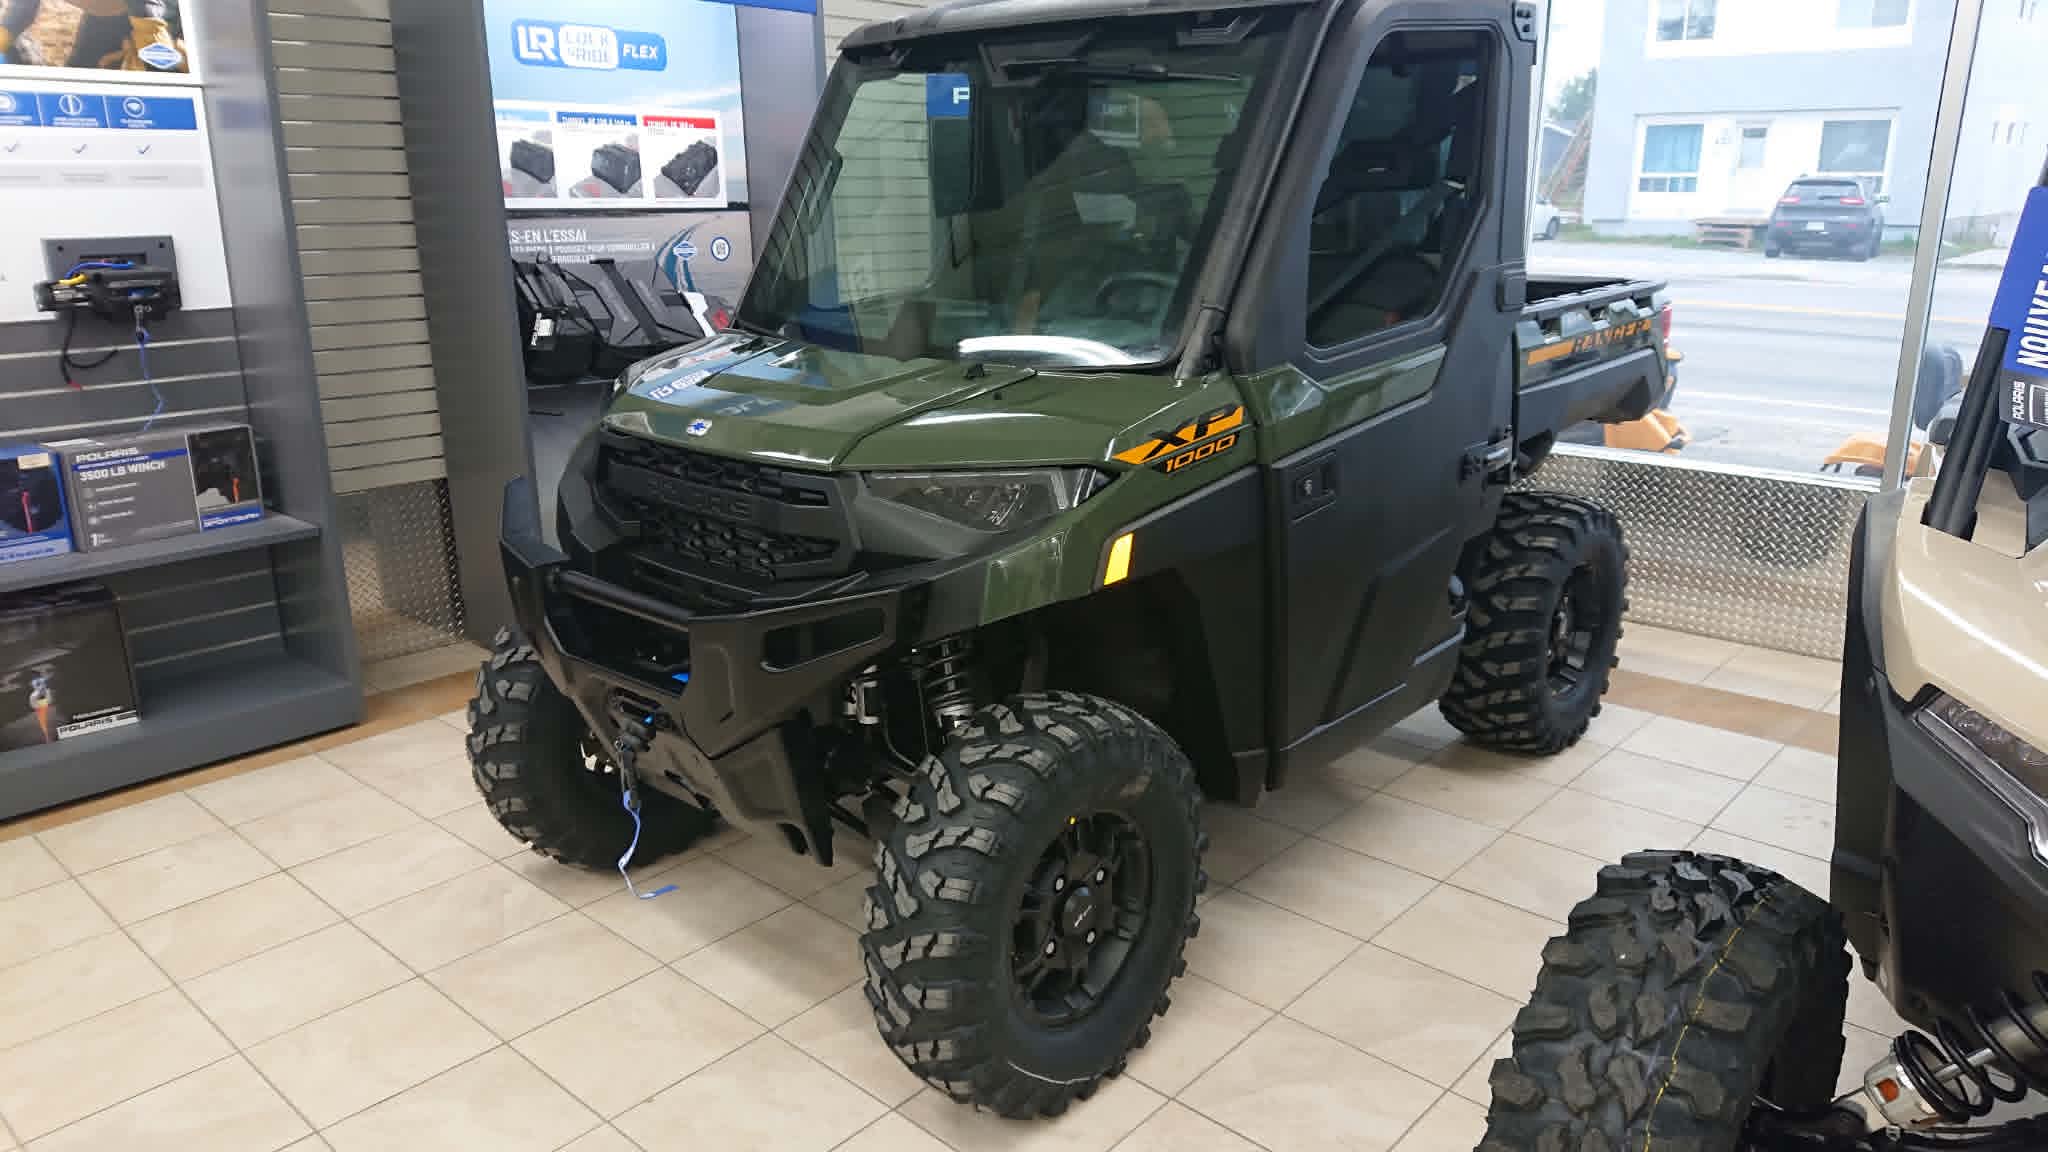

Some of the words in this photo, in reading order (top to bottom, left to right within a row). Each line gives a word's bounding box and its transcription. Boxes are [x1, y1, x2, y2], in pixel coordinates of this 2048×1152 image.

[516, 25, 558, 61] LR
[622, 43, 658, 59] FLEX
[543, 228, 587, 242] L'ESSAI
[2016, 251, 2048, 369] NOUV
[2012, 381, 2026, 420] POLARIS
[1142, 403, 1240, 461] XP
[75, 447, 139, 464] POLARIS
[110, 465, 127, 477] LB
[127, 459, 166, 474] WINCH
[1165, 433, 1237, 473] 1000
